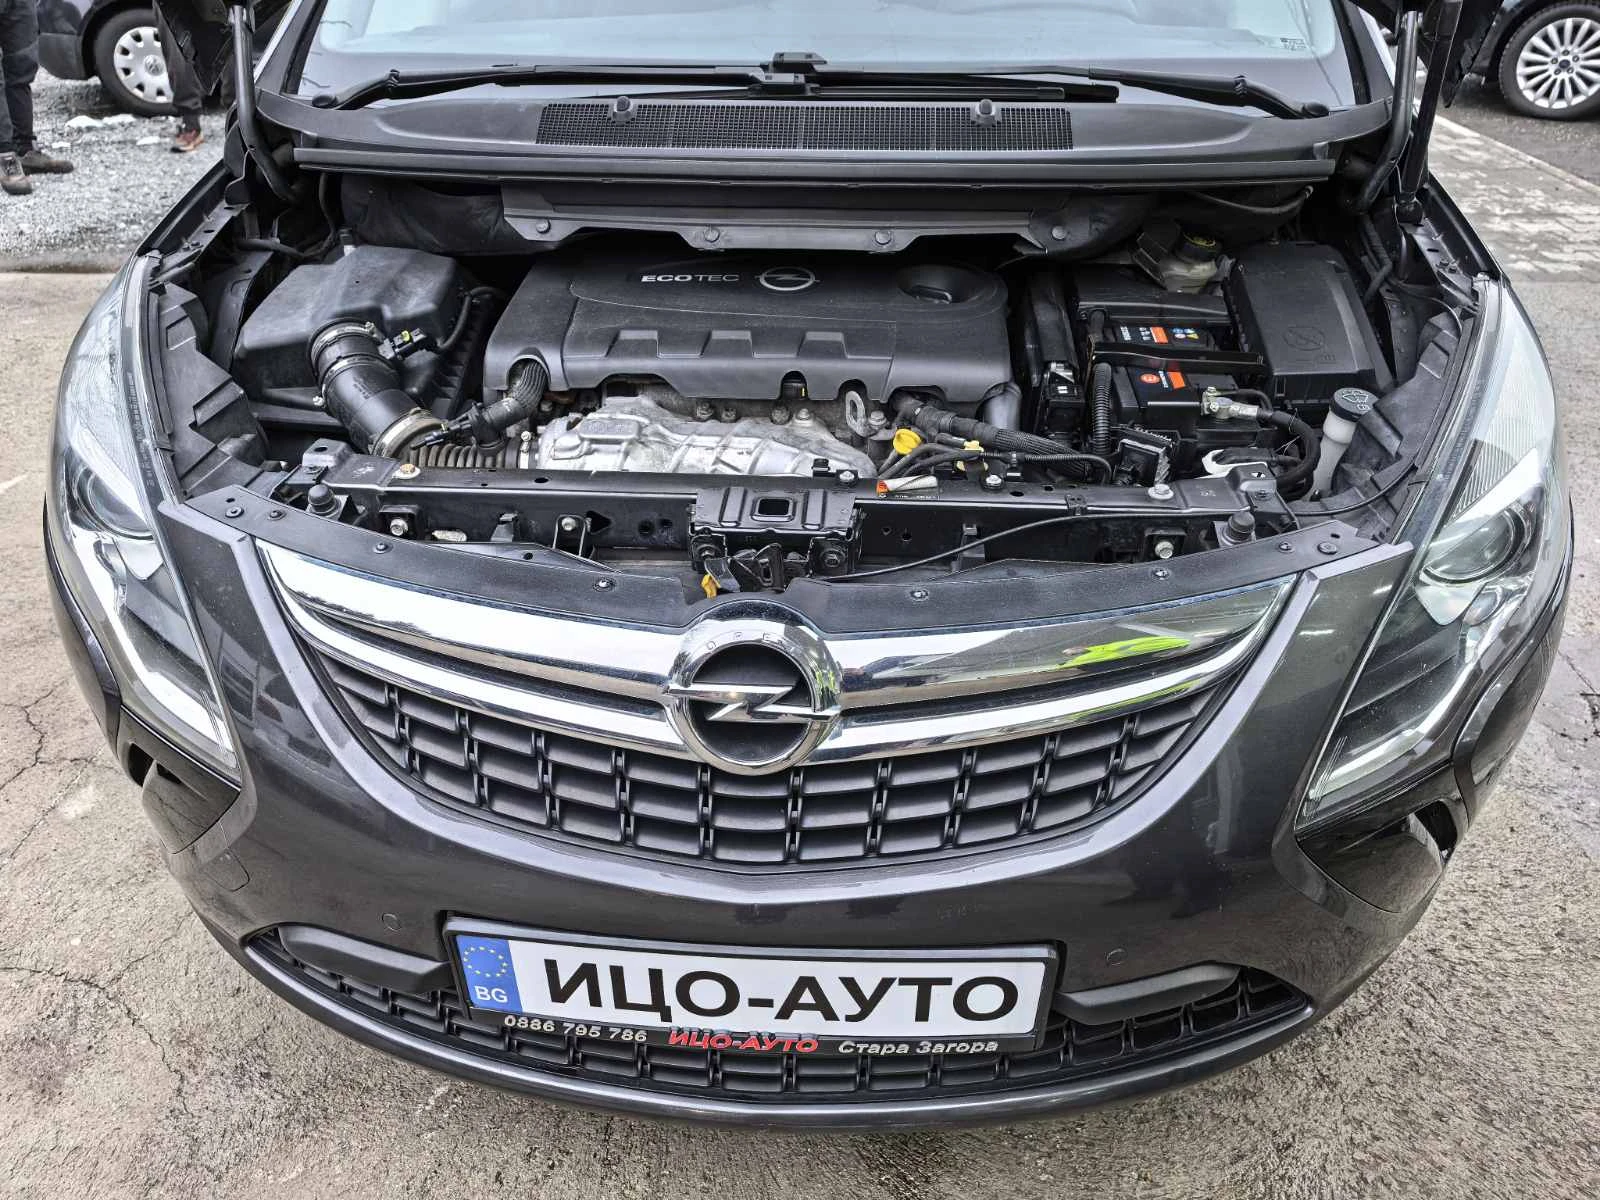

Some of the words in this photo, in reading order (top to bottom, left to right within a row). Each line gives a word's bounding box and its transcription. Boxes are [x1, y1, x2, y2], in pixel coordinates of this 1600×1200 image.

[641, 274, 739, 282] ECOTEC
[474, 985, 508, 1003] BG
[544, 958, 1019, 1023] ИЦО-АУТО
[504, 1015, 555, 1033] 0886
[563, 1022, 601, 1038] 795
[609, 1026, 648, 1042] 786
[668, 1027, 819, 1053] ИЦО-АУТО
[838, 1040, 908, 1055] Стара
[916, 1040, 999, 1054] Загора
